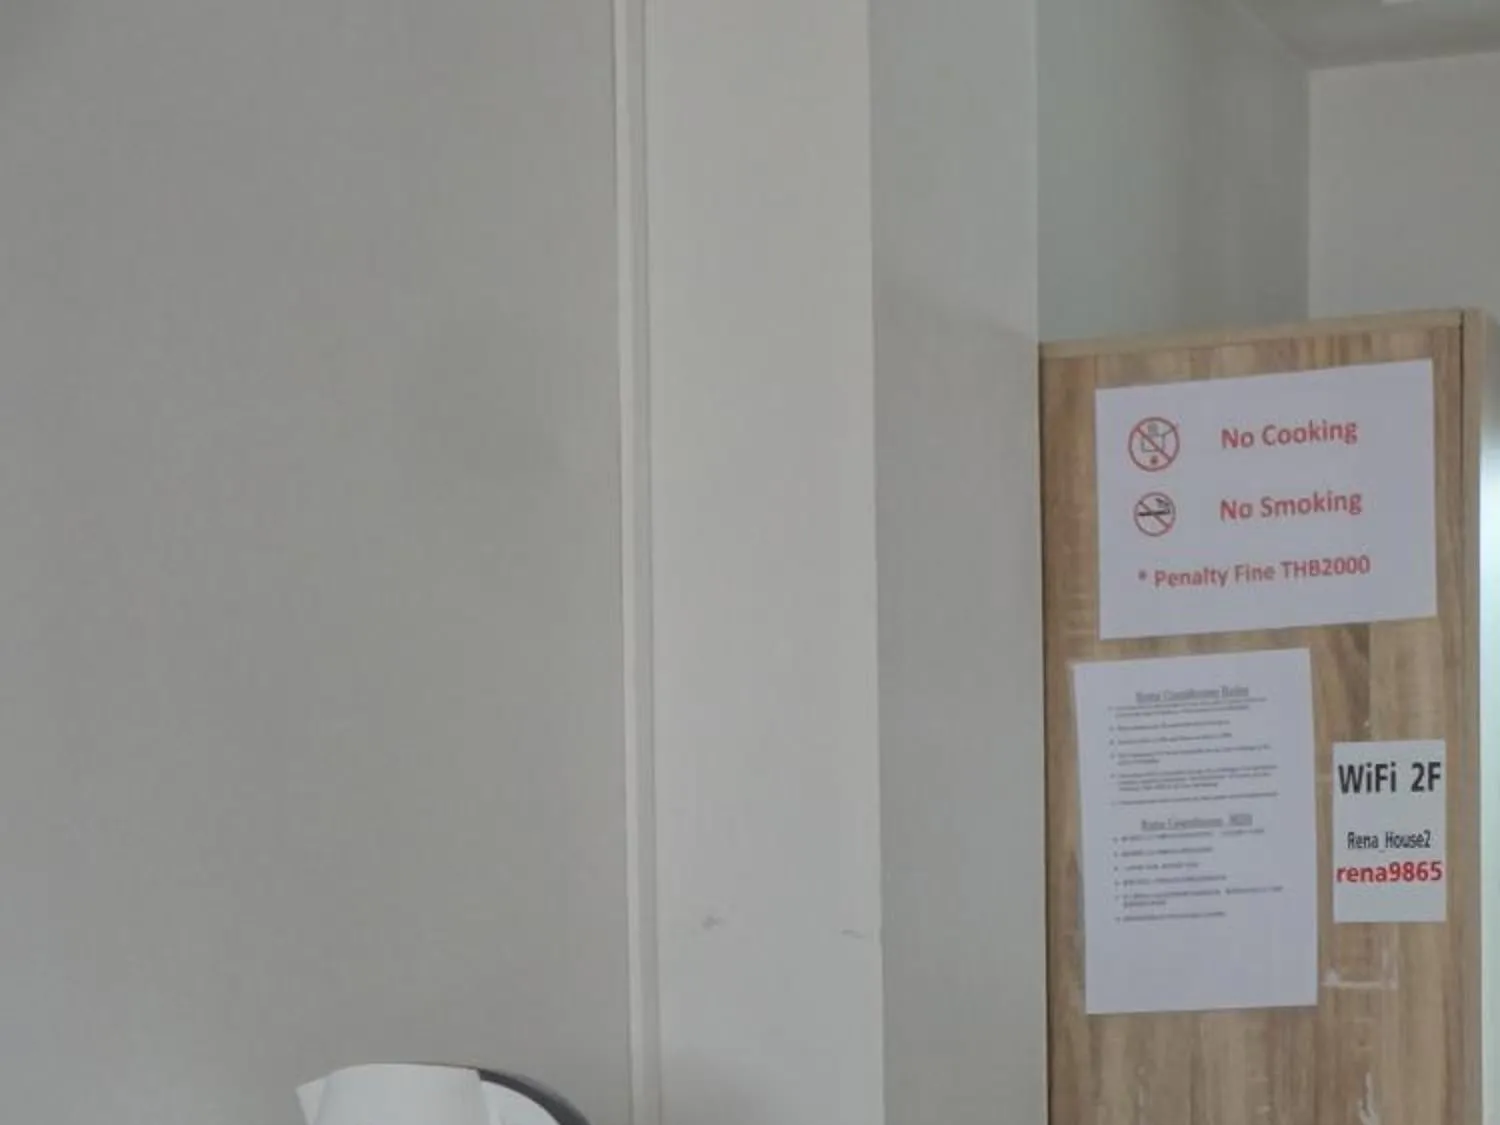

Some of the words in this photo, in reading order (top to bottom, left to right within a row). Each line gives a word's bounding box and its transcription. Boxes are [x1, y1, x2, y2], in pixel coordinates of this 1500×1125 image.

[1221, 427, 1255, 448] No
[1262, 419, 1358, 447] Cooking
[1219, 498, 1252, 520] No
[1260, 490, 1363, 518] Smoking
[1154, 567, 1228, 588] Penalty
[1235, 565, 1275, 583] Fine
[1281, 555, 1371, 579] THB2000
[1338, 762, 1397, 794] WiFi
[1411, 761, 1441, 792] 2F
[1337, 860, 1442, 882] rena9865
